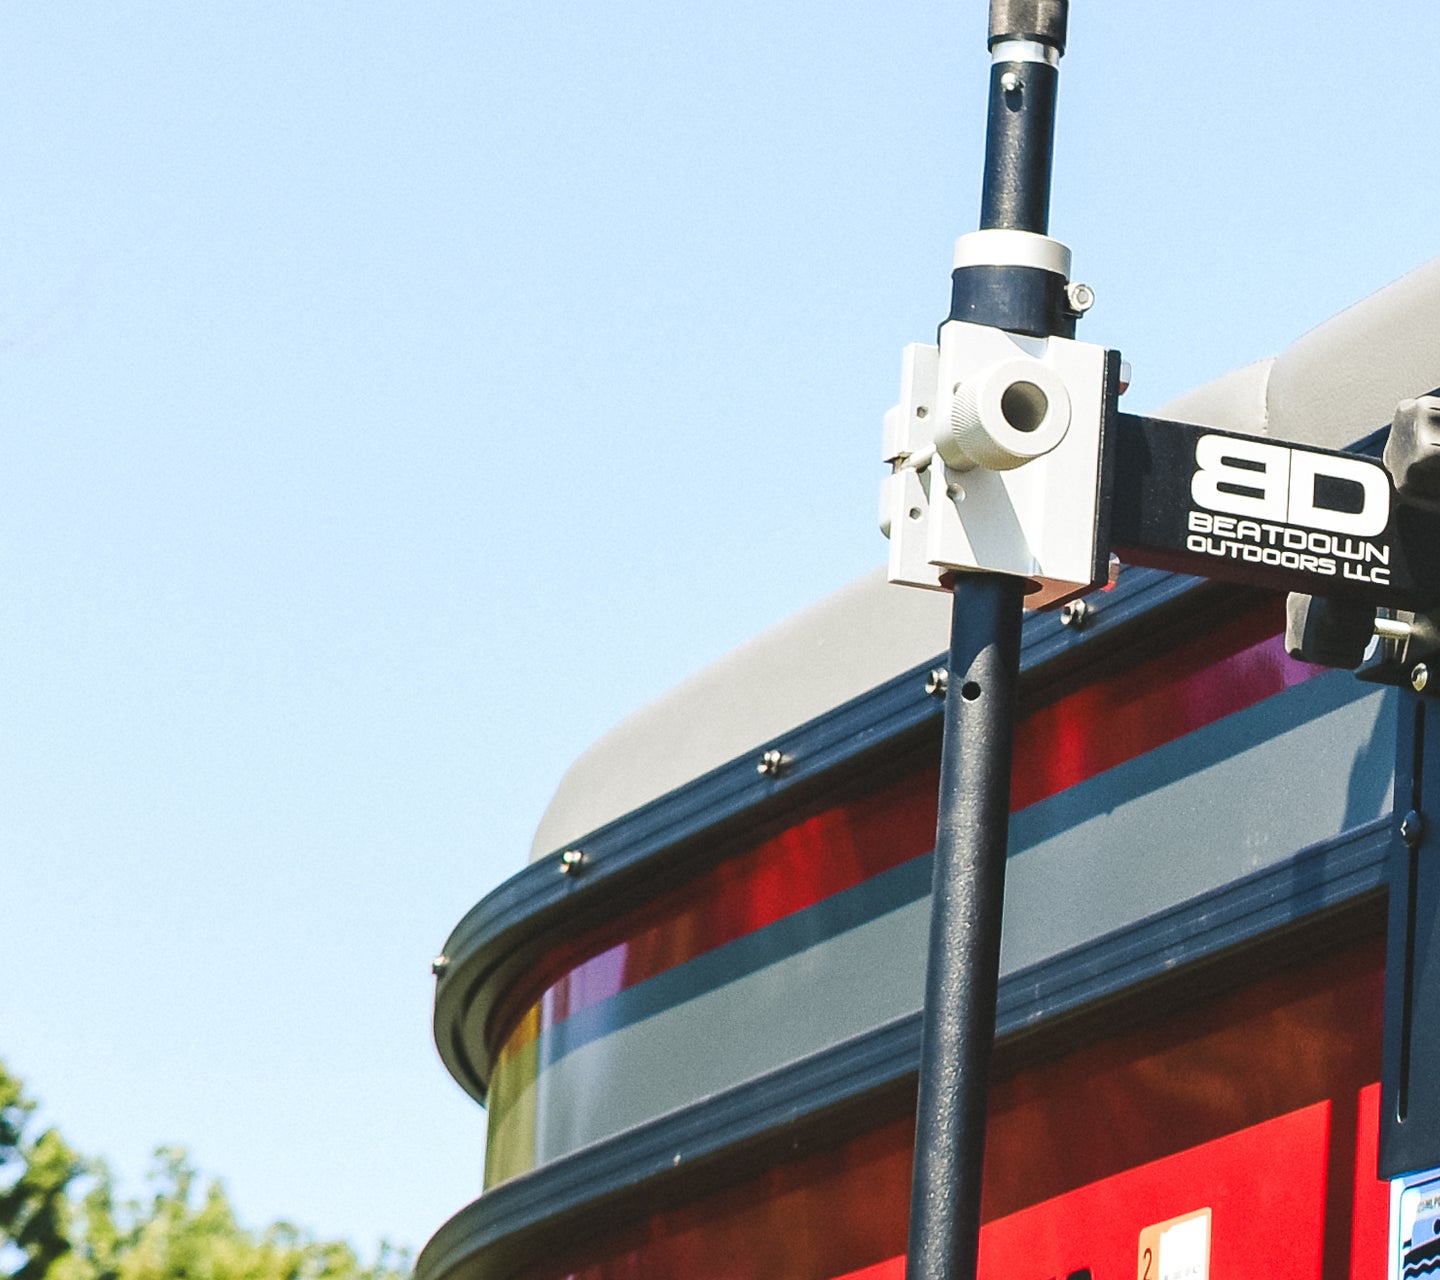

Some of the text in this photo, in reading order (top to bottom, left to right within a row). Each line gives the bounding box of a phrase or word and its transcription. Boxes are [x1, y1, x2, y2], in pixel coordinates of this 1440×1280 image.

[1190, 433, 1391, 538] BD
[1186, 534, 1391, 586] OUTDOORS LLC
[1187, 510, 1390, 566] BEATDOWN
